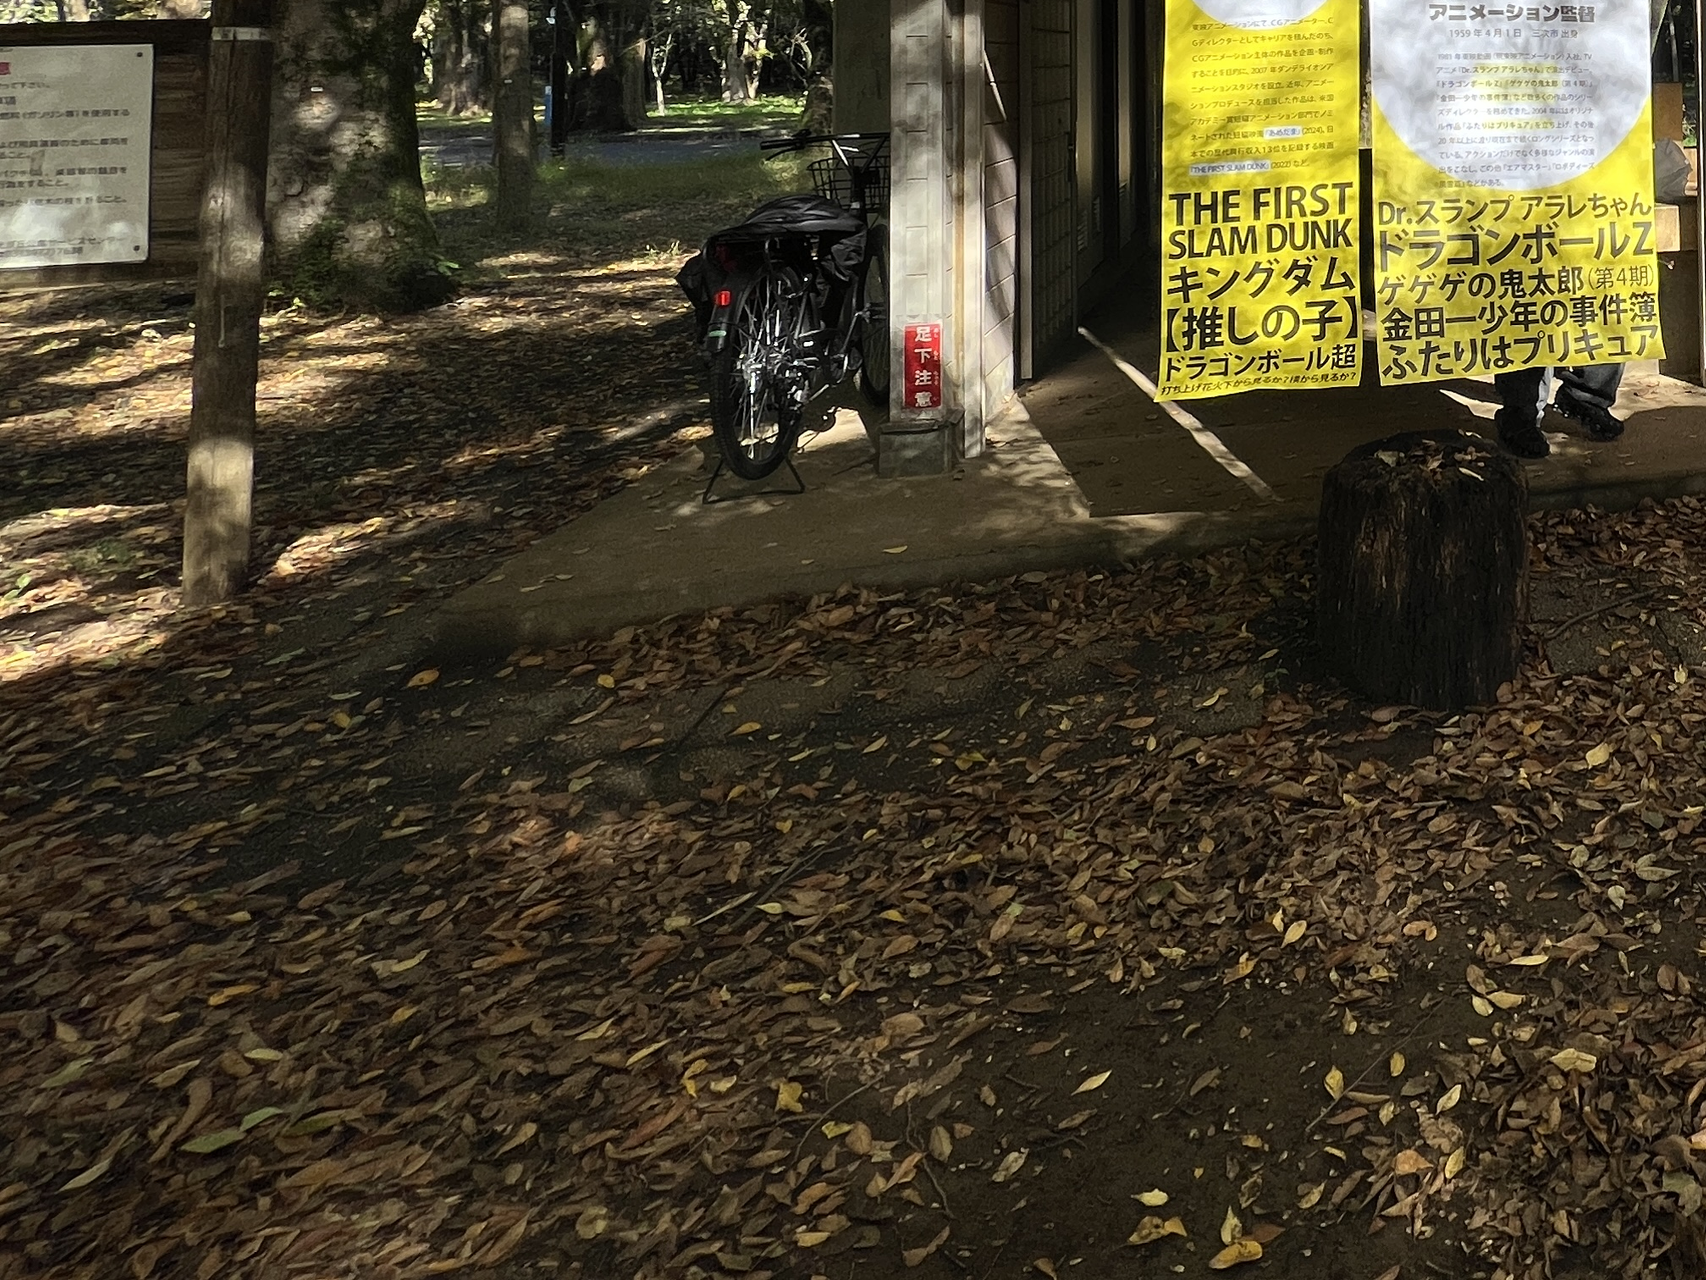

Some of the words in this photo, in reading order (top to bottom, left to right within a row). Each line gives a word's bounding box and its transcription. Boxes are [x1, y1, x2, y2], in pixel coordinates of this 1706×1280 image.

[1429, 2, 1596, 23] アニメーション監督
[1168, 190, 1240, 226] THE
[1253, 182, 1353, 221] FIRST
[1379, 195, 1515, 225] Dr.スランプ
[1521, 192, 1652, 220] アラレちゃん
[1168, 226, 1258, 260] SLAM
[1266, 218, 1353, 252] DUNK
[1379, 221, 1654, 272] ドラゴンボールZ
[1167, 255, 1356, 303] キングダム
[1165, 296, 1358, 353] 【推しの子】
[1382, 292, 1658, 342] 金田一少年の事件簿
[914, 326, 933, 407] 足下注意
[1166, 344, 1356, 382] ドラゴンボール超
[1382, 324, 1658, 378] ふたりはプリキュア
